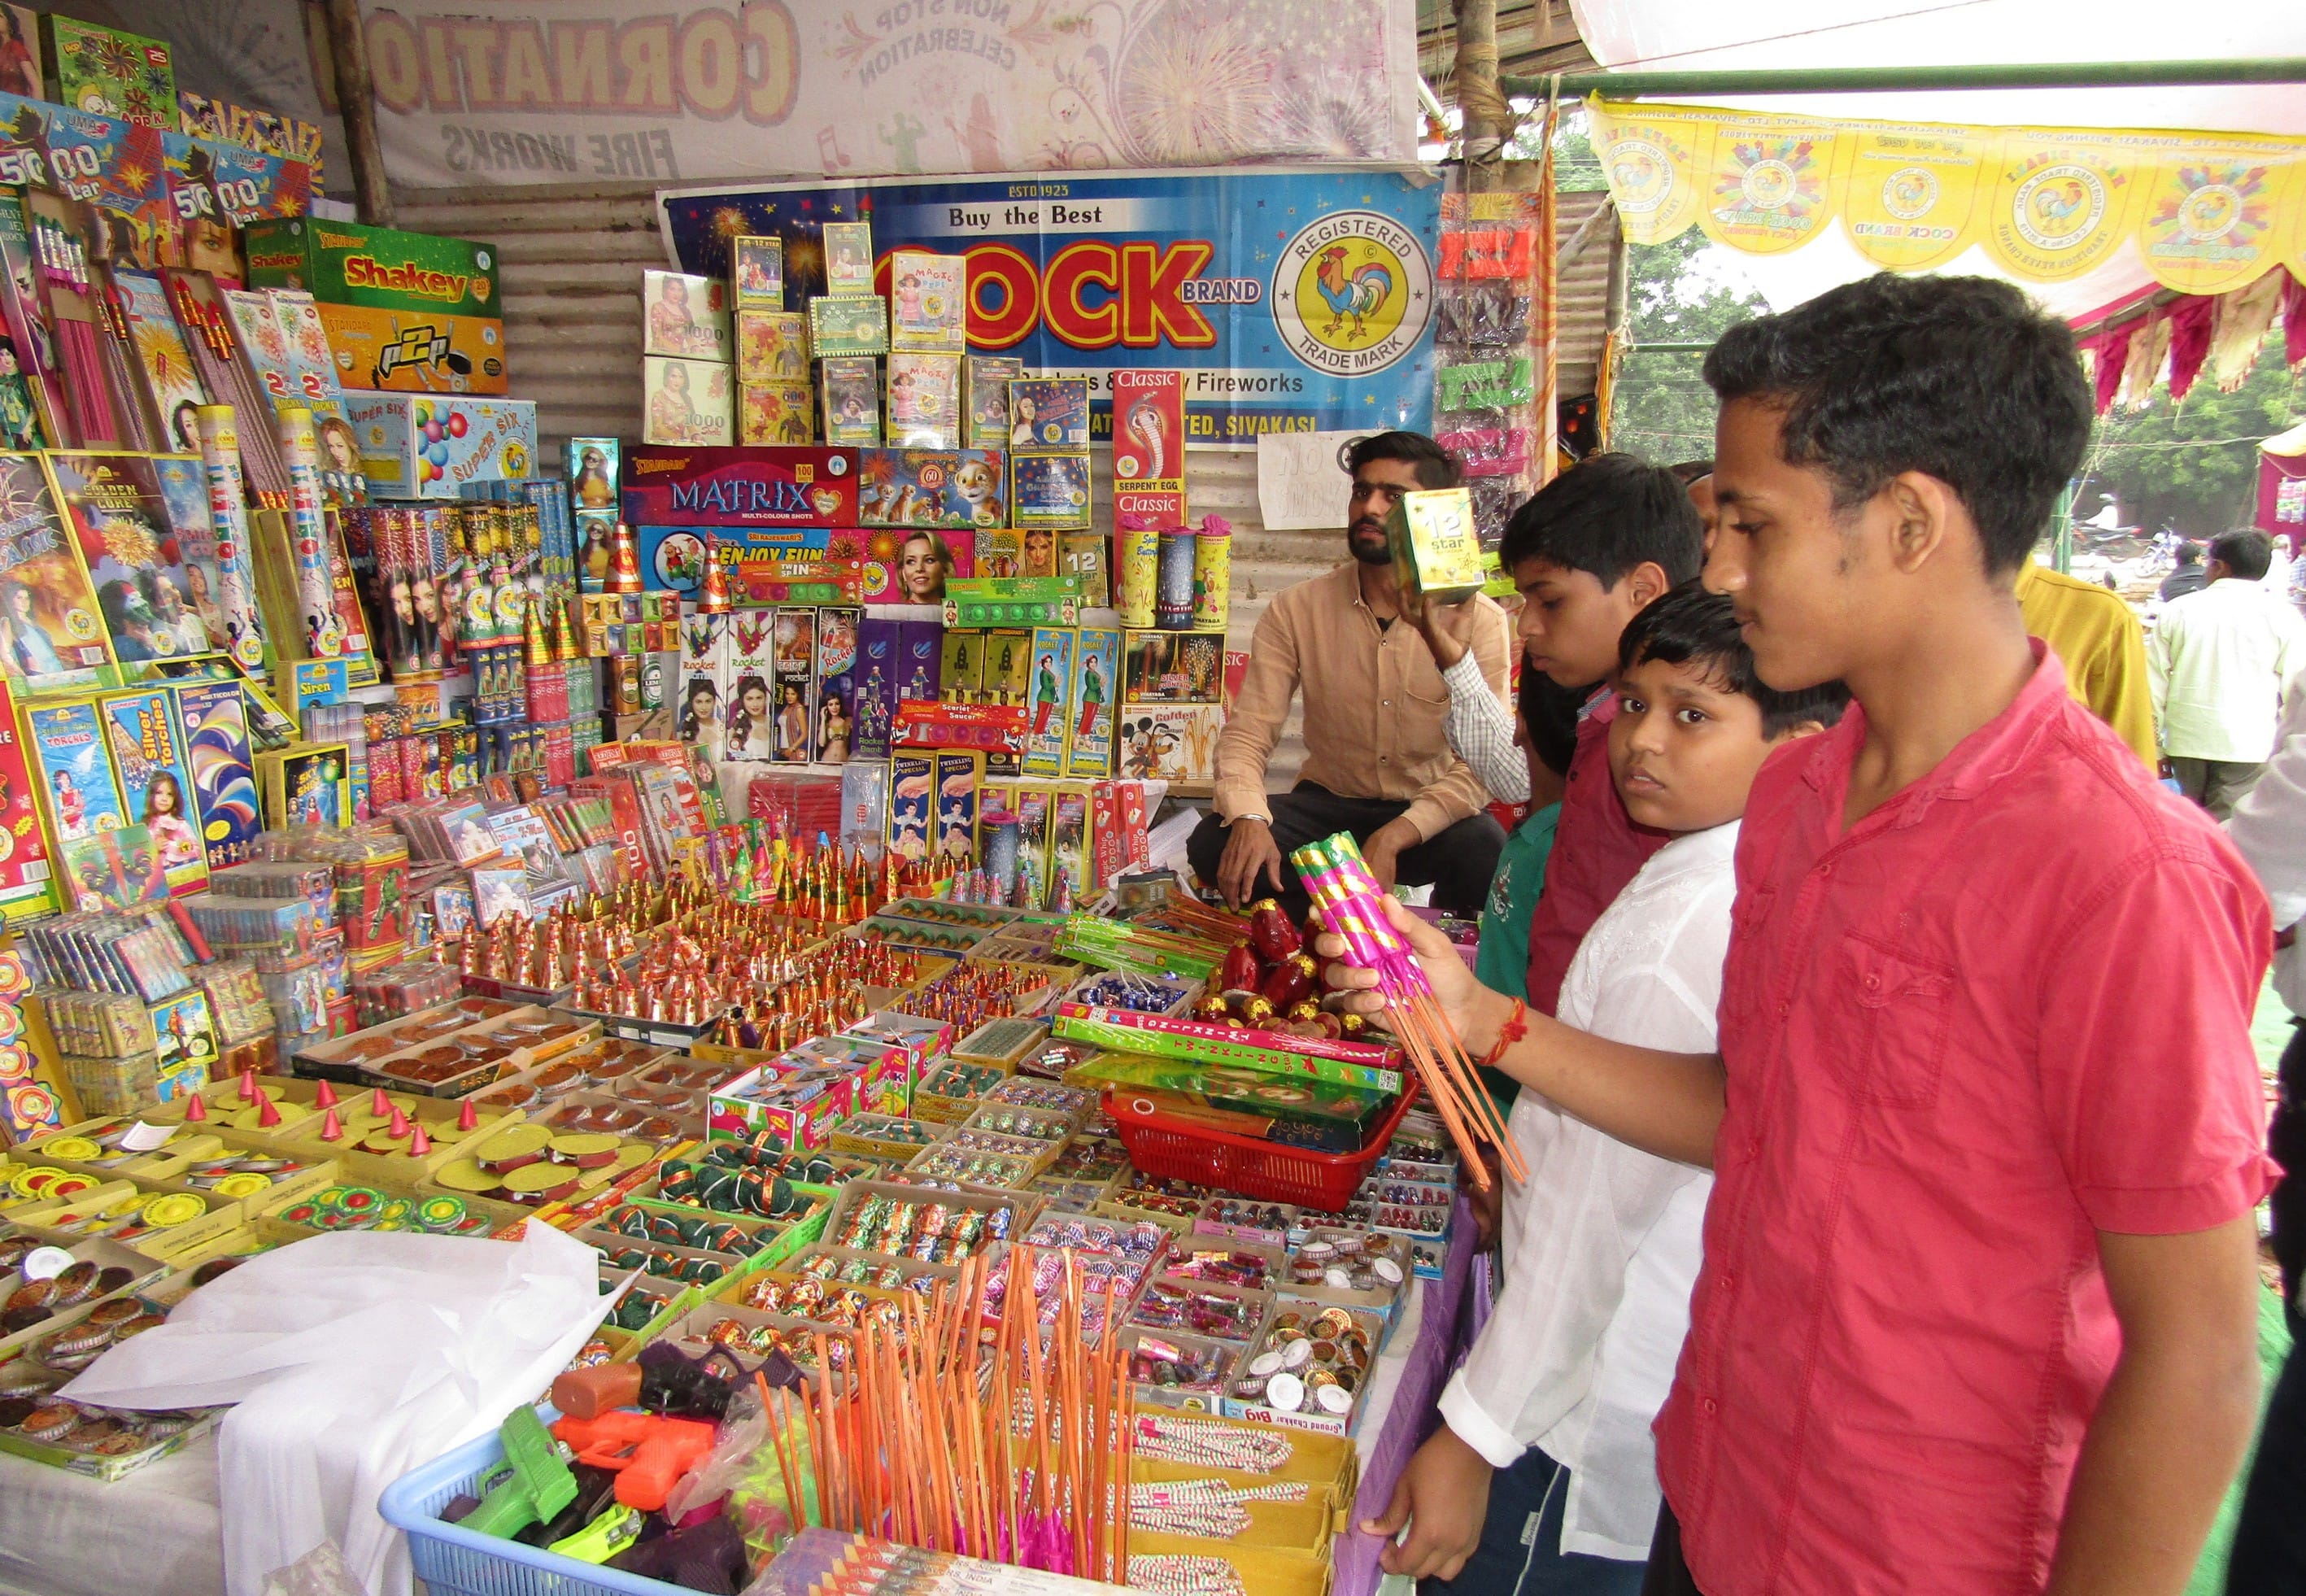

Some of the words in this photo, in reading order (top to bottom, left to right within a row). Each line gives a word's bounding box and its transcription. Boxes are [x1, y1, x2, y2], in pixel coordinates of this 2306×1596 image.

[67, 181, 101, 203] Lar
[172, 179, 259, 220] 5000
[1009, 185, 1038, 198] ESTD
[1040, 185, 1069, 197] 1923
[949, 207, 991, 229] Buy
[1004, 205, 1040, 226] the
[1052, 204, 1102, 225] Best
[1294, 220, 1412, 260] REGISTERED
[251, 253, 303, 268] Shakey
[344, 253, 469, 303] Shakey
[875, 241, 1218, 350] OCK
[1180, 281, 1261, 303] BRAND
[1298, 335, 1351, 368] TRADE
[1354, 335, 1404, 368] MARK
[1118, 371, 1175, 387] Classic
[1197, 373, 1303, 392] Fireworks
[496, 412, 521, 435] SIX
[797, 465, 812, 476] 100
[925, 470, 938, 482] 60
[84, 484, 138, 496] GOLDEN
[1119, 482, 1157, 491] SERPENT
[670, 479, 814, 512] MATRIX
[1119, 495, 1176, 512] Classic
[1425, 513, 1463, 539] 12
[1431, 539, 1464, 550] star
[719, 547, 781, 565] ENJOY
[1066, 552, 1096, 571] 12
[683, 659, 716, 669] Rocket
[732, 656, 765, 667] Rocket
[825, 646, 854, 668] Rocket
[300, 682, 332, 696] Siren
[942, 704, 971, 712] Scarlet
[949, 712, 976, 720] Saucer
[1155, 710, 1197, 722] Golden
[47, 733, 93, 748] TORCHES
[137, 710, 158, 760] Silver
[150, 698, 176, 768] Torches
[858, 737, 885, 746] Rocket
[939, 757, 972, 767] TWINKLING
[944, 764, 970, 772] SPECIAL
[624, 830, 642, 869] 100
[1101, 836, 1109, 858] Whip
[1148, 1019, 1249, 1041] TWINKLING
[1175, 1040, 1279, 1064] TWINKLING
[1282, 1053, 1292, 1073] Star
[810, 1104, 840, 1133] SWASTIK
[1245, 1408, 1272, 1423] Big
[1276, 1415, 1309, 1428] Chakkar
[1310, 1422, 1339, 1433] Ground
[965, 1572, 993, 1585] INDIA
